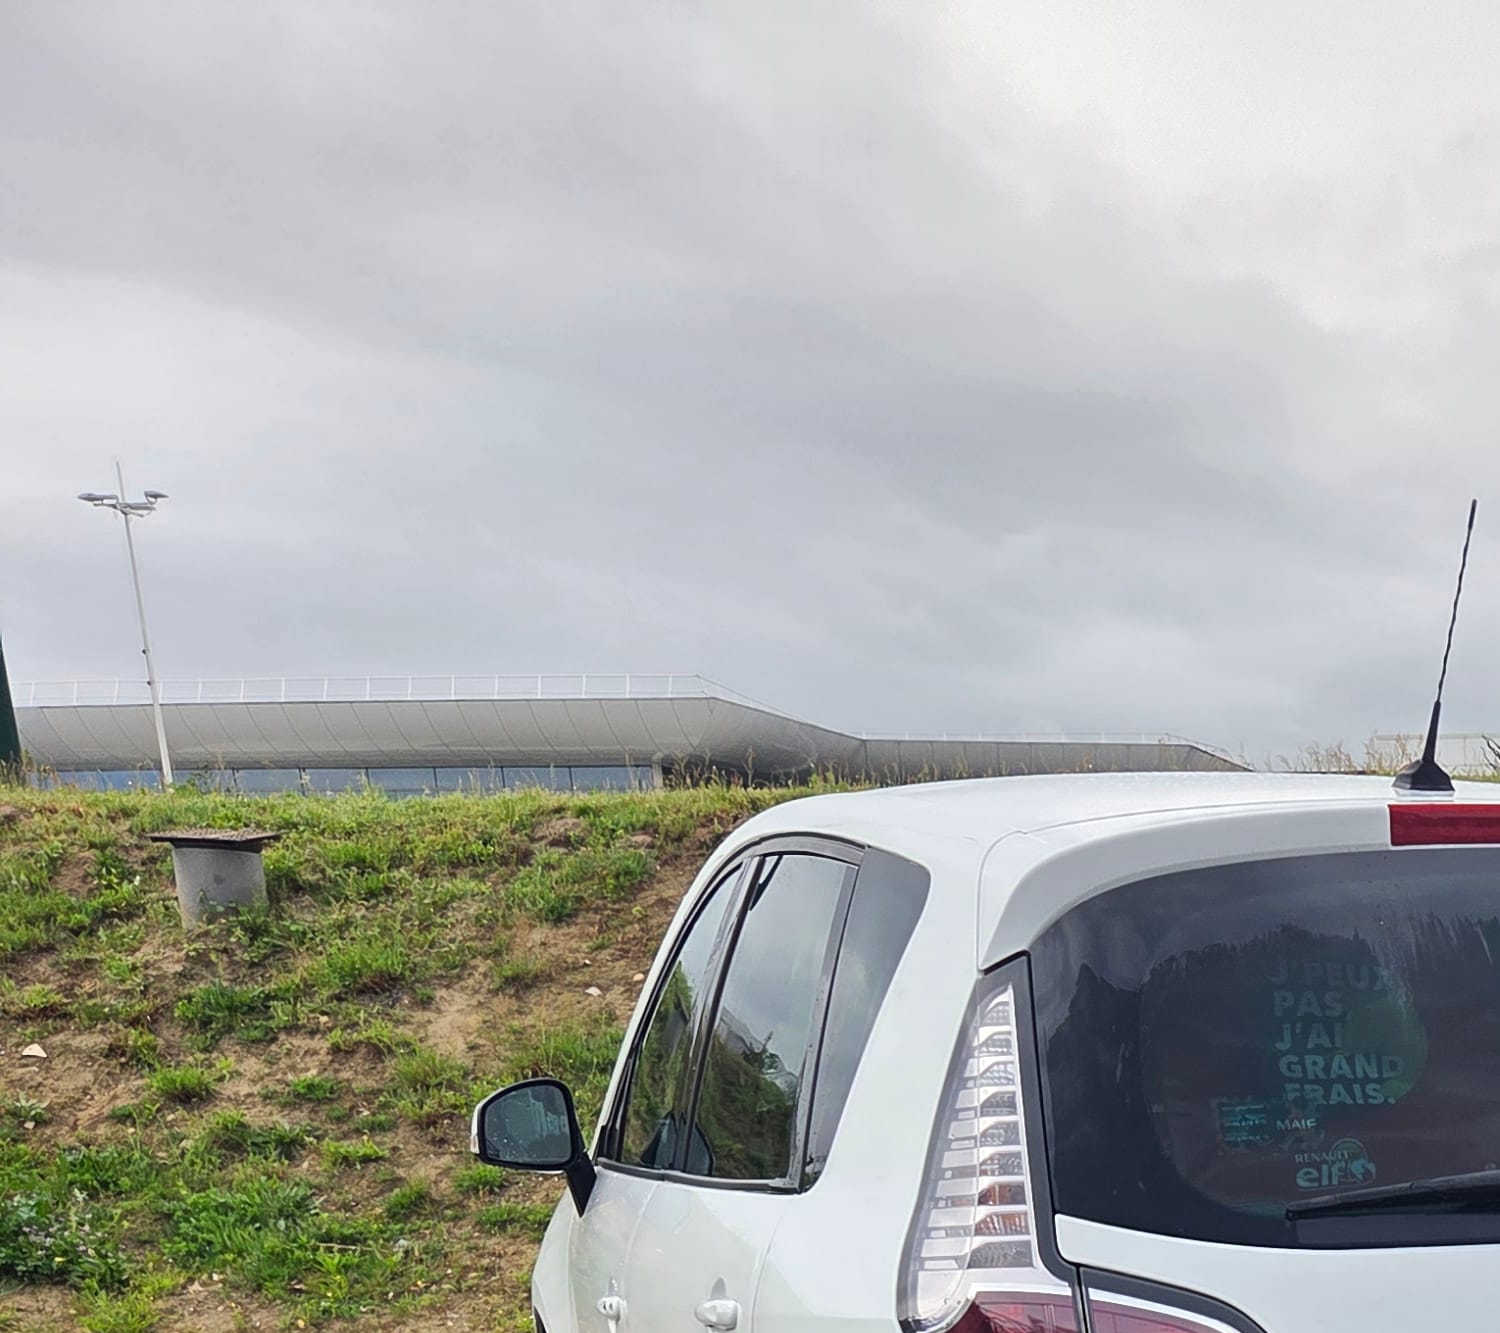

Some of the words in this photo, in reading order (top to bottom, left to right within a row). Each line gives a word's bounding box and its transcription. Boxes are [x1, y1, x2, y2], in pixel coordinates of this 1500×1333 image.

[1275, 1023, 1342, 1050] J'AI
[1278, 1054, 1402, 1079] GRAND
[1275, 1118, 1318, 1131] MAIF
[1294, 1149, 1350, 1164] RENAULT
[1295, 1163, 1345, 1187] elf
